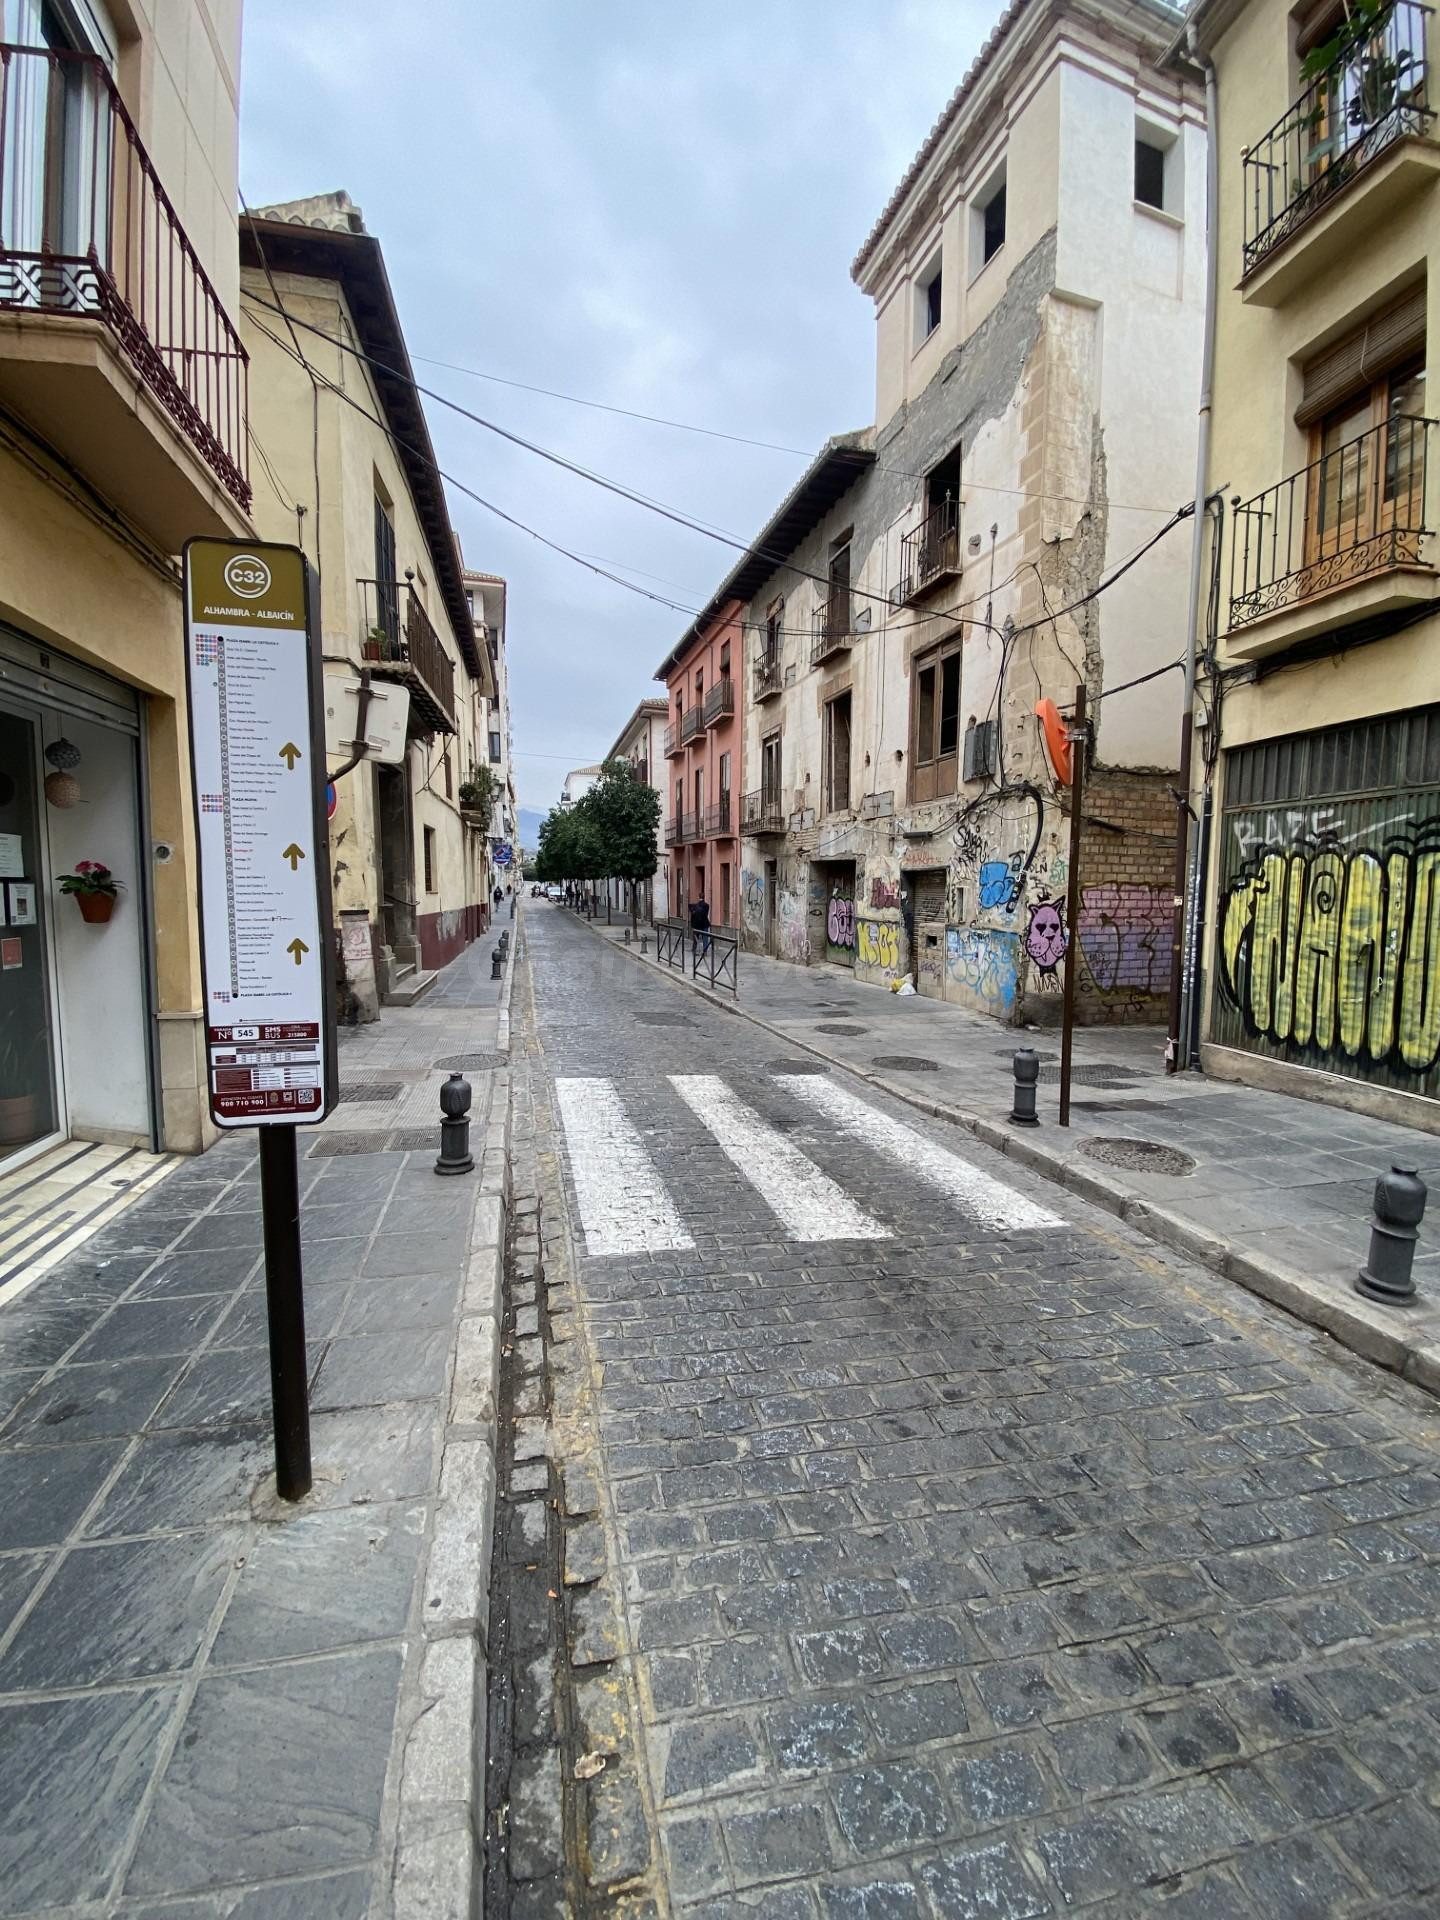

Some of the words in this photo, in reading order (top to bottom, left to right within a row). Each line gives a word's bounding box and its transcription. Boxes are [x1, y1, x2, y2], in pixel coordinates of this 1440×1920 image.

[230, 568, 266, 585] C32
[203, 606, 251, 617] ALHAMBRA
[256, 609, 294, 621] ALBAICÍN
[237, 1029, 254, 1038] 545
